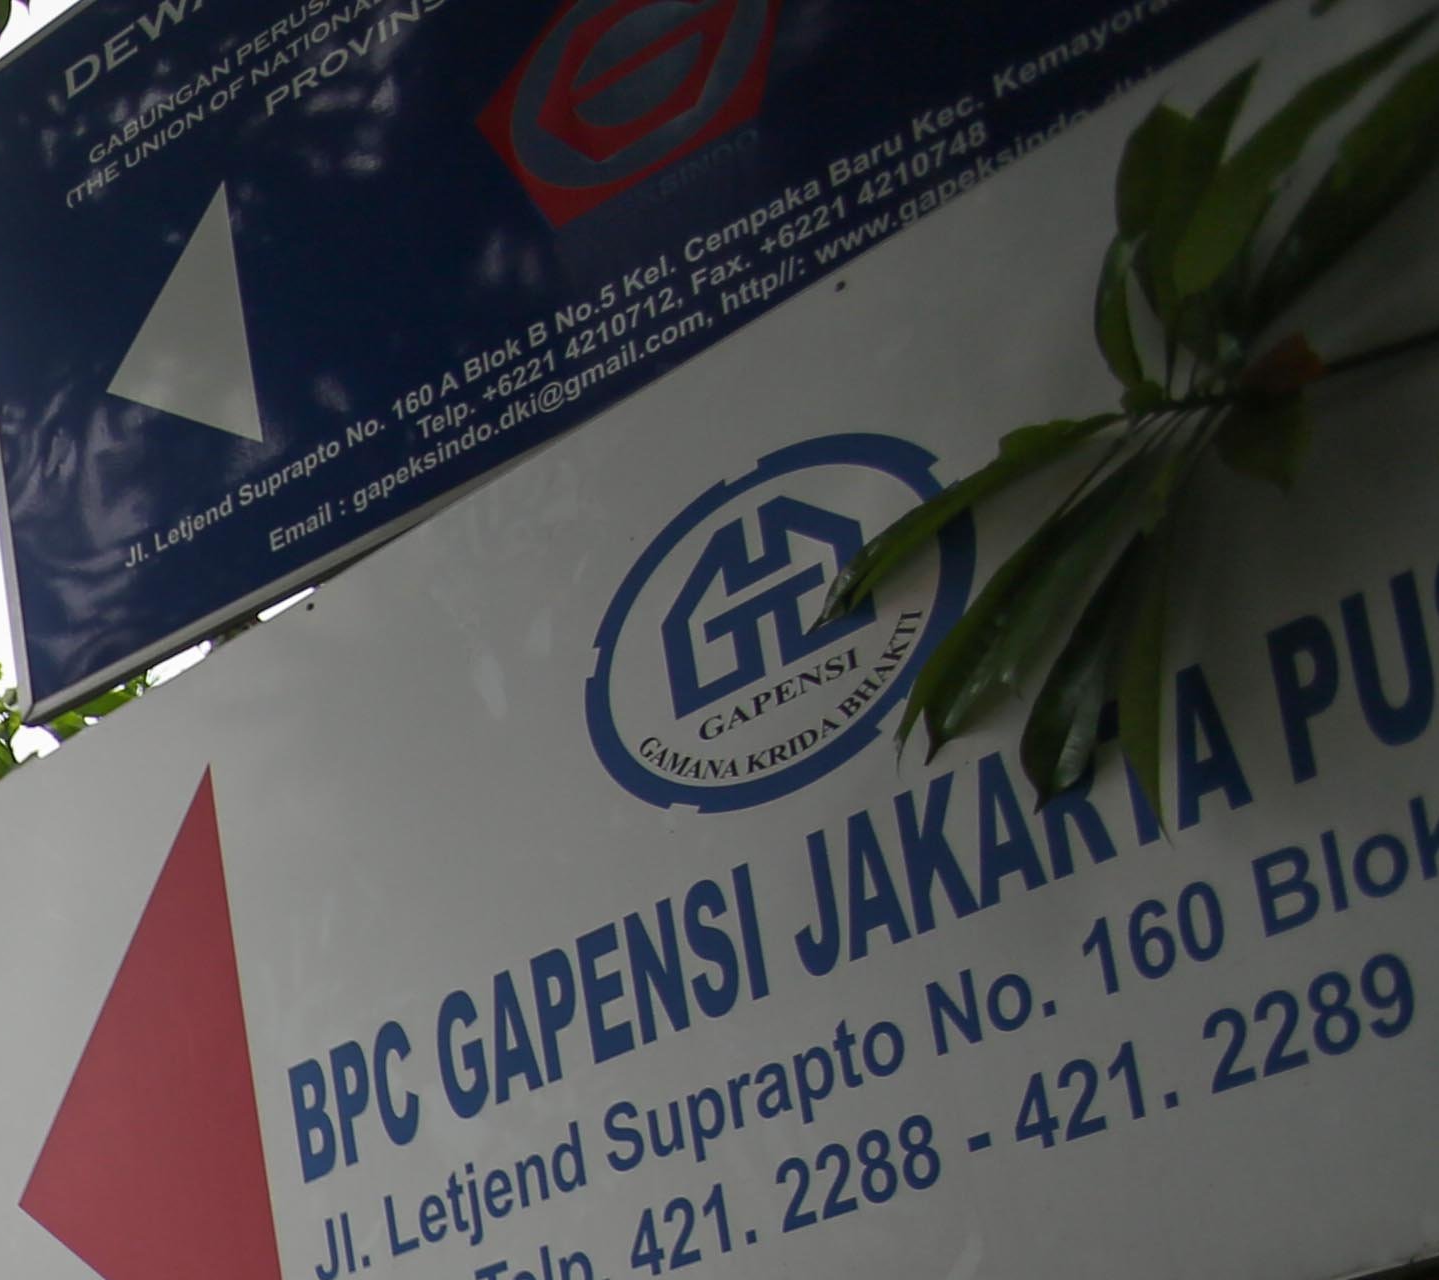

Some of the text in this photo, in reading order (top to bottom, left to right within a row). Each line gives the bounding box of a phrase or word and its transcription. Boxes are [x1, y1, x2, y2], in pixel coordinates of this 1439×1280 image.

[64, 0, 204, 98] DEW
[66, 0, 382, 209] (THE UNION OF NATIONA
[89, 0, 332, 164] GABUNGAN PERUS
[124, 0, 1176, 568] Jl. Letjend Suprapto No. 160 A Blok B No.5 Kel. Cempaka Baru Kec. Kemayora
[416, 119, 989, 441] Telp. +6221 4210712, Fax. +6221 4210748
[269, 501, 332, 552] Email
[639, 608, 924, 781] GAMANA KRIDA BHAKTI
[699, 647, 859, 741] GAPENSI
[286, 1019, 420, 1184] BPC
[435, 863, 770, 1118] GAPENSI
[1267, 568, 1439, 785] PU
[383, 1122, 588, 1263] Letjend
[604, 1015, 907, 1202] Suprapto
[927, 963, 1058, 1057] No.
[1082, 880, 1226, 996] 160
[776, 1112, 944, 1237] 2288
[1014, 1039, 1182, 1155] 421.
[1201, 948, 1417, 1098] 2289
